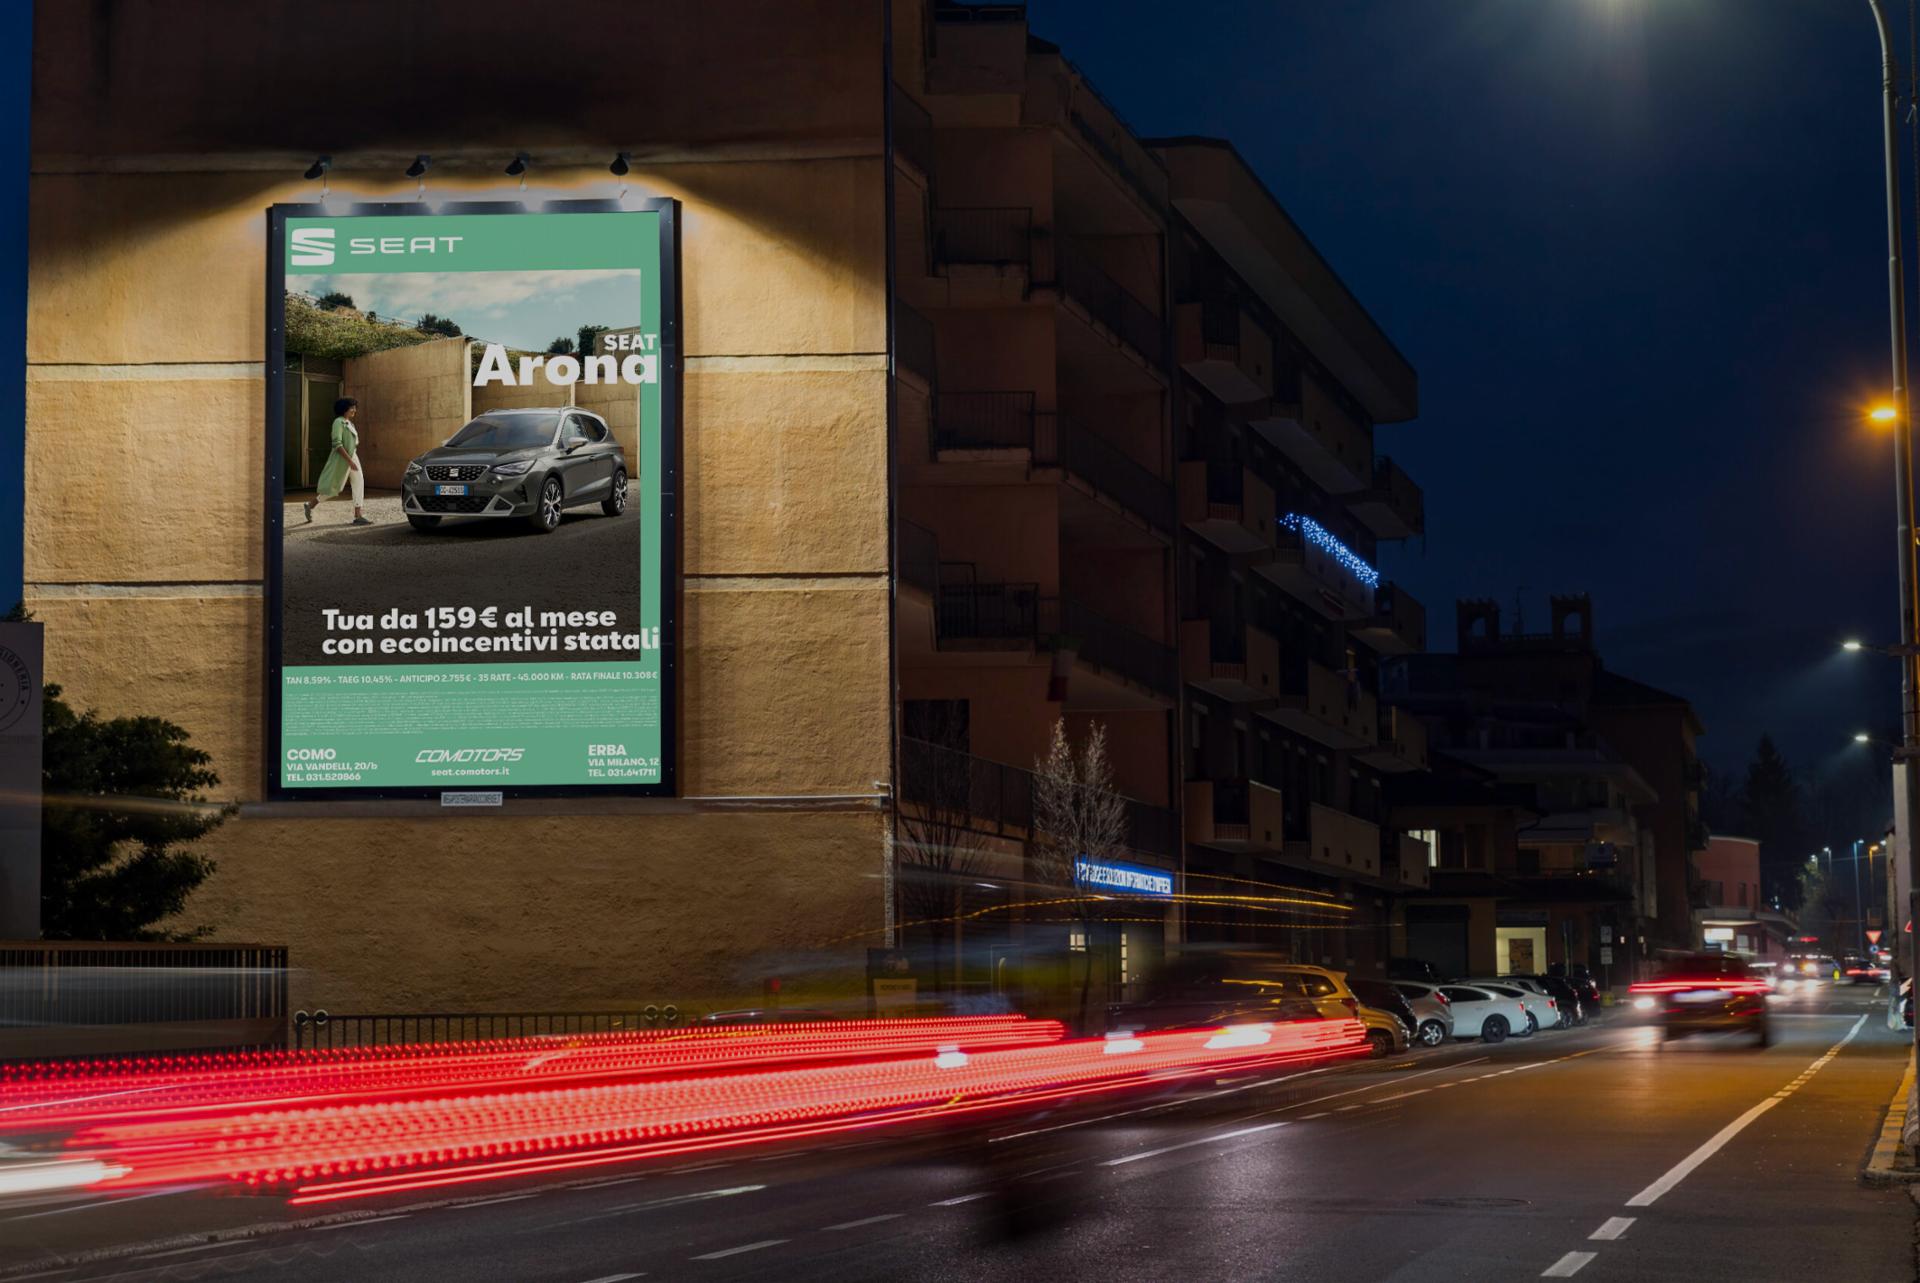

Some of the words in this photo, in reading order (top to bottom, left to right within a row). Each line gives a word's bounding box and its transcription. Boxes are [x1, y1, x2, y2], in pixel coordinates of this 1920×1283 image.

[350, 237, 463, 254] SEAT
[605, 334, 656, 350] SEAT
[473, 343, 657, 387] Arona
[322, 609, 373, 630] Tua
[381, 608, 417, 629] da
[505, 606, 534, 627] al
[541, 611, 616, 627] mese
[323, 639, 373, 654] con
[380, 629, 557, 654] ecoincentivi
[564, 626, 660, 651] statali
[285, 676, 301, 685] TAN
[337, 675, 360, 684] TAEG
[361, 675, 393, 684] 10.45%
[399, 674, 441, 683] ANTICIPO
[478, 673, 490, 682] 35
[491, 673, 512, 682] RATE
[517, 672, 550, 682] 45.000
[550, 672, 565, 681] KM
[571, 672, 592, 681] RATA
[593, 671, 621, 680] FINALE
[286, 748, 337, 761] COMO
[415, 747, 525, 763] COMOTORS
[588, 744, 627, 756] ERBA
[286, 763, 304, 771] VIA
[305, 762, 353, 771] VANDELLI,
[354, 761, 378, 771] 20/b
[588, 758, 606, 767] VIA
[607, 757, 648, 767] MILANO,
[649, 757, 660, 766] 12
[286, 773, 305, 782] TEL.
[431, 766, 510, 776] seat.comotors.it
[587, 768, 606, 777] TEL.
